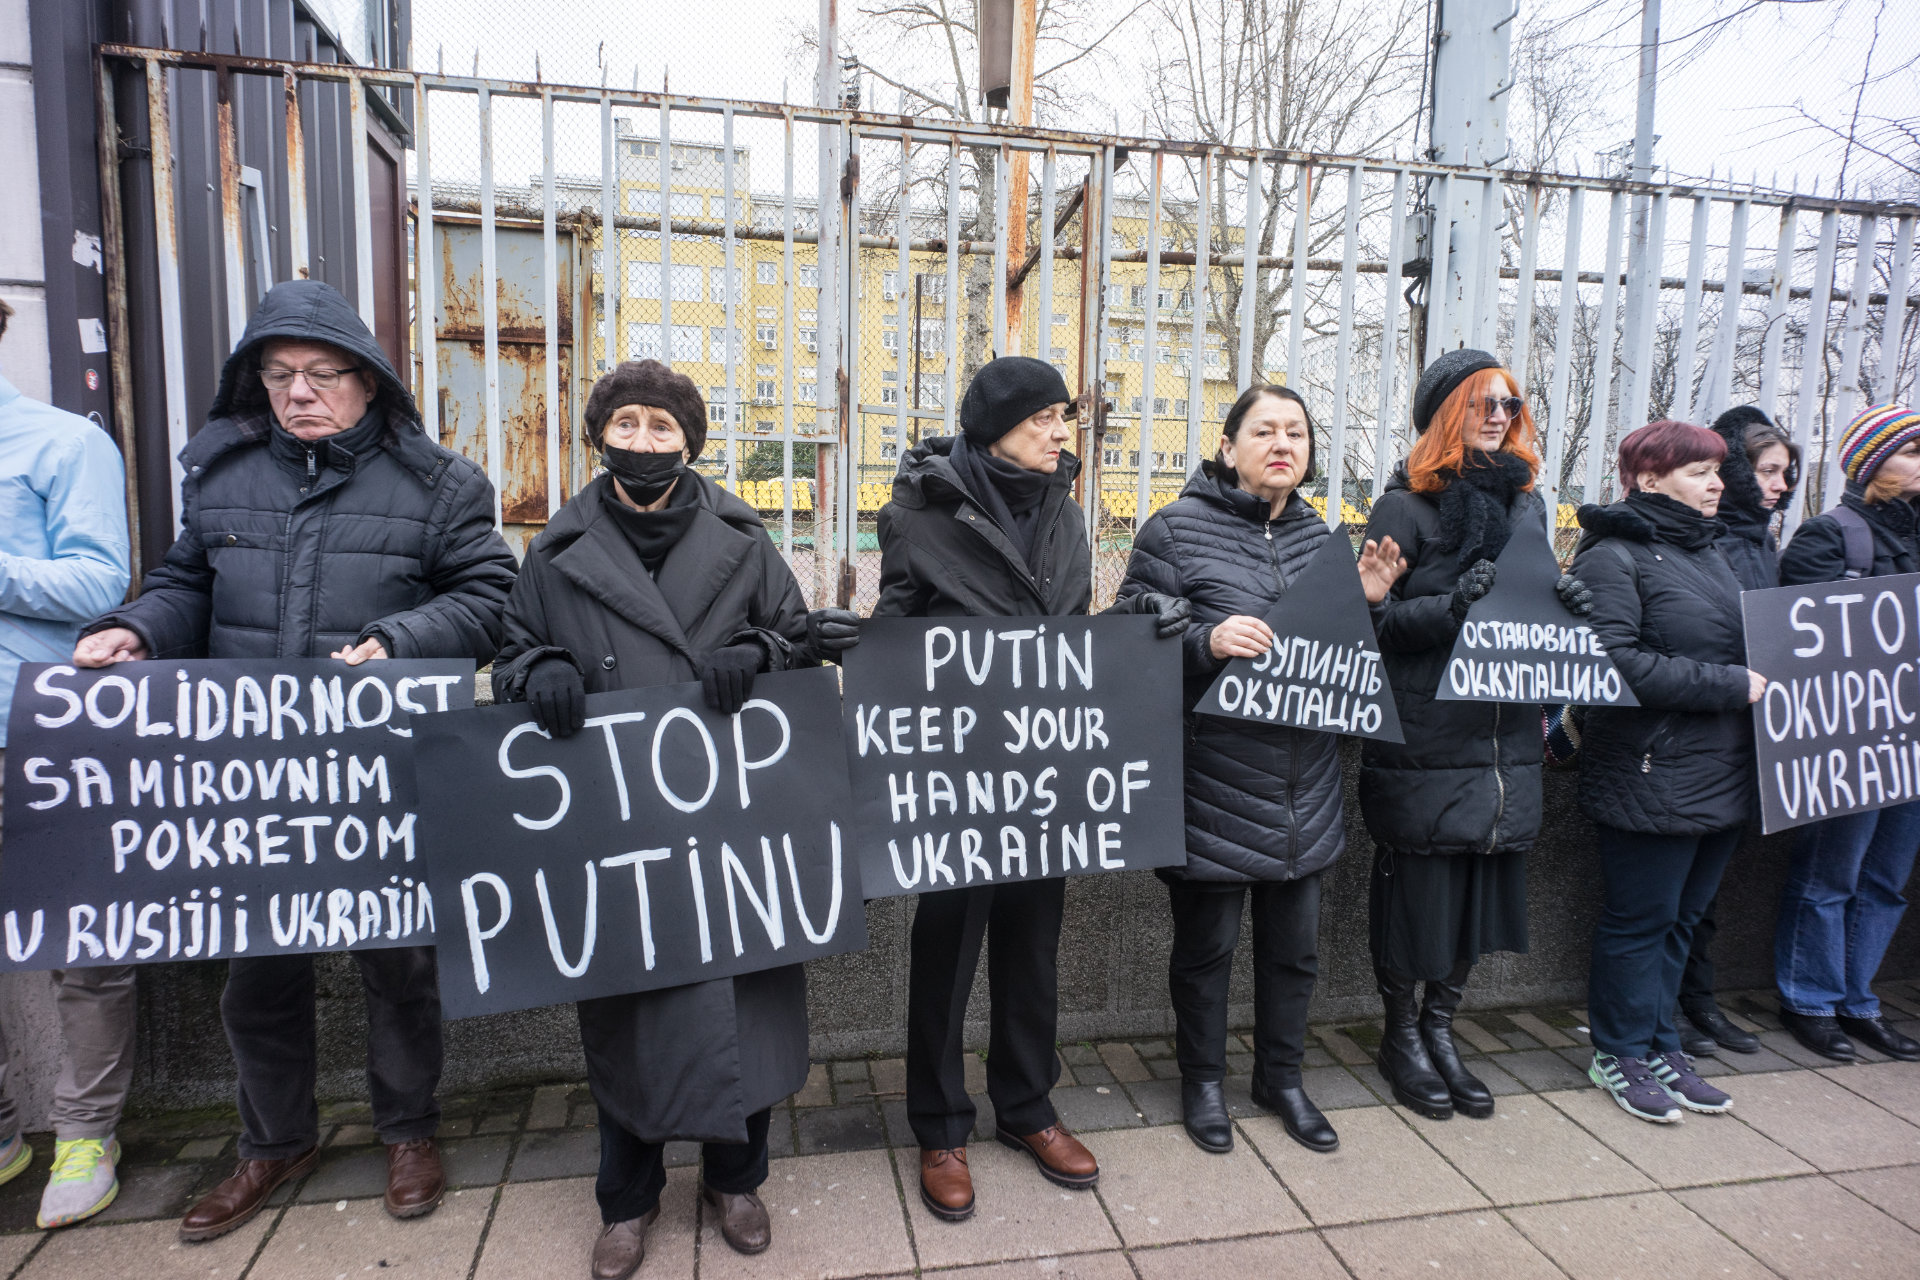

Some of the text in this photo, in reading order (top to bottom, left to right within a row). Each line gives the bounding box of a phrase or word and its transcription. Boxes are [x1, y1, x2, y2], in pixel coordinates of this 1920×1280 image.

[1462, 620, 1608, 657] ОСТАНОВИТЕ
[1789, 584, 1920, 658] STO
[1218, 675, 1382, 733] ОКУПАЦЮ
[1450, 657, 1621, 702] ОККУПАЦИЮ
[1764, 657, 1920, 743] OKUPAC
[856, 703, 1109, 757] KEEP YOUR
[24, 756, 114, 811] SA
[498, 698, 791, 831] STOP
[888, 760, 1151, 823] HANDS OF
[111, 812, 417, 874] POKRETOM
